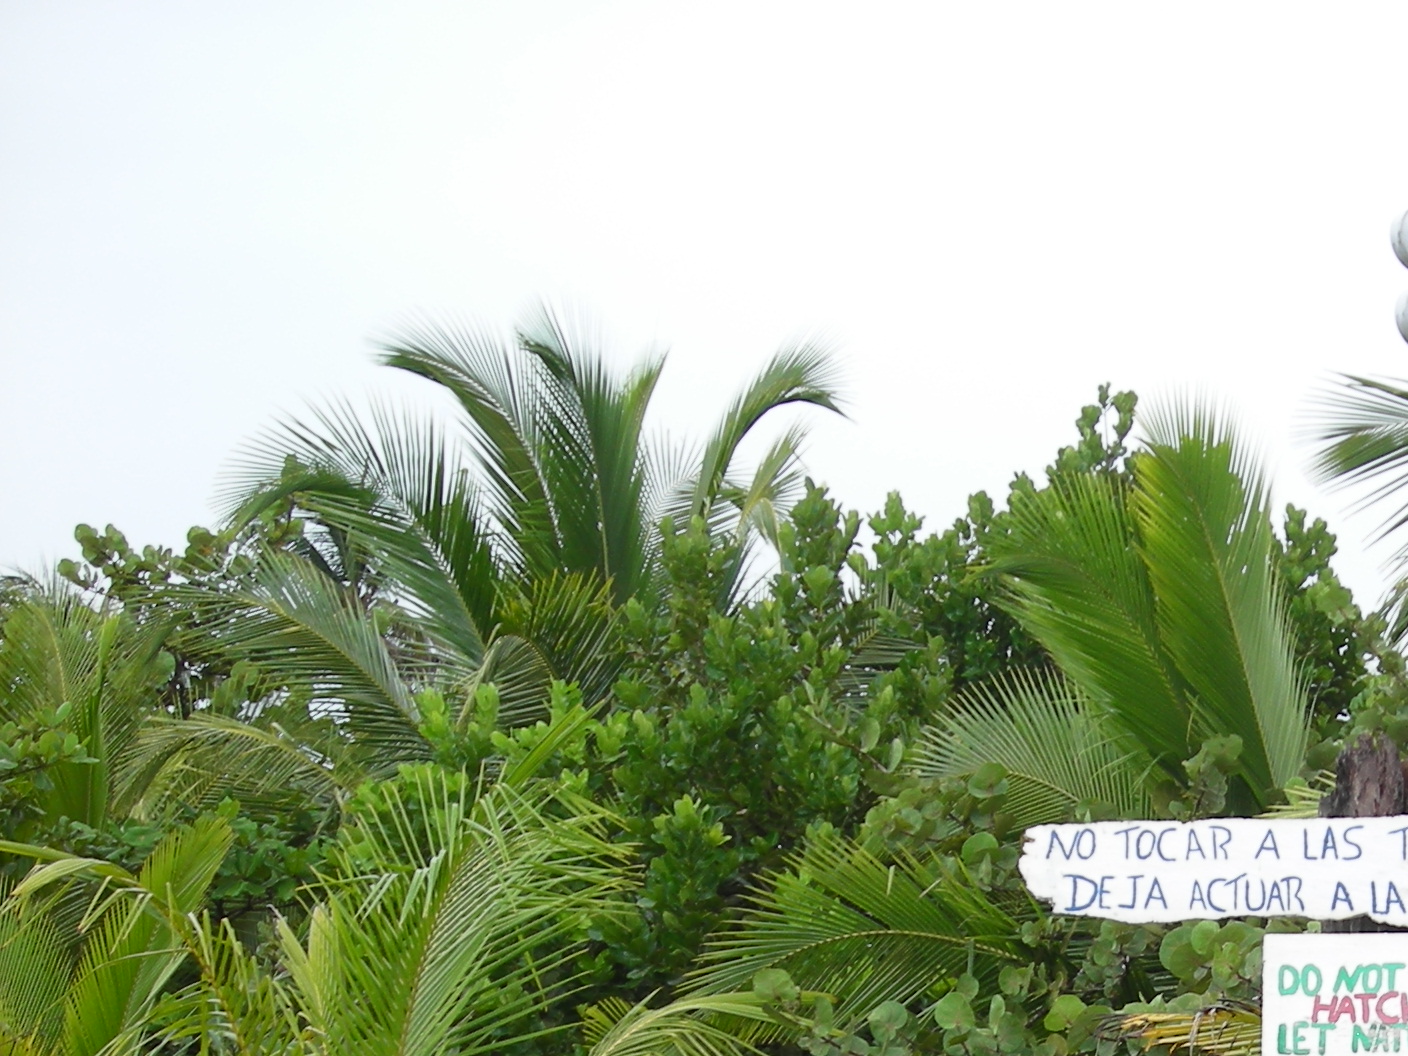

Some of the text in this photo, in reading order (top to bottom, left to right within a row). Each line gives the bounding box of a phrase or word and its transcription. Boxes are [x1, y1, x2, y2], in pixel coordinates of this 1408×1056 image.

[1046, 828, 1096, 860] NO
[1114, 826, 1232, 861] TOCAR
[1254, 829, 1280, 860] A
[1304, 826, 1364, 860] LAS
[1063, 874, 1168, 912] DEJA
[1190, 873, 1304, 912] ACTUAR
[1332, 881, 1354, 911] A
[1371, 881, 1406, 914] LA
[1278, 964, 1323, 996] DO
[1333, 962, 1406, 994] NOT
[1277, 1021, 1336, 1056] LET
